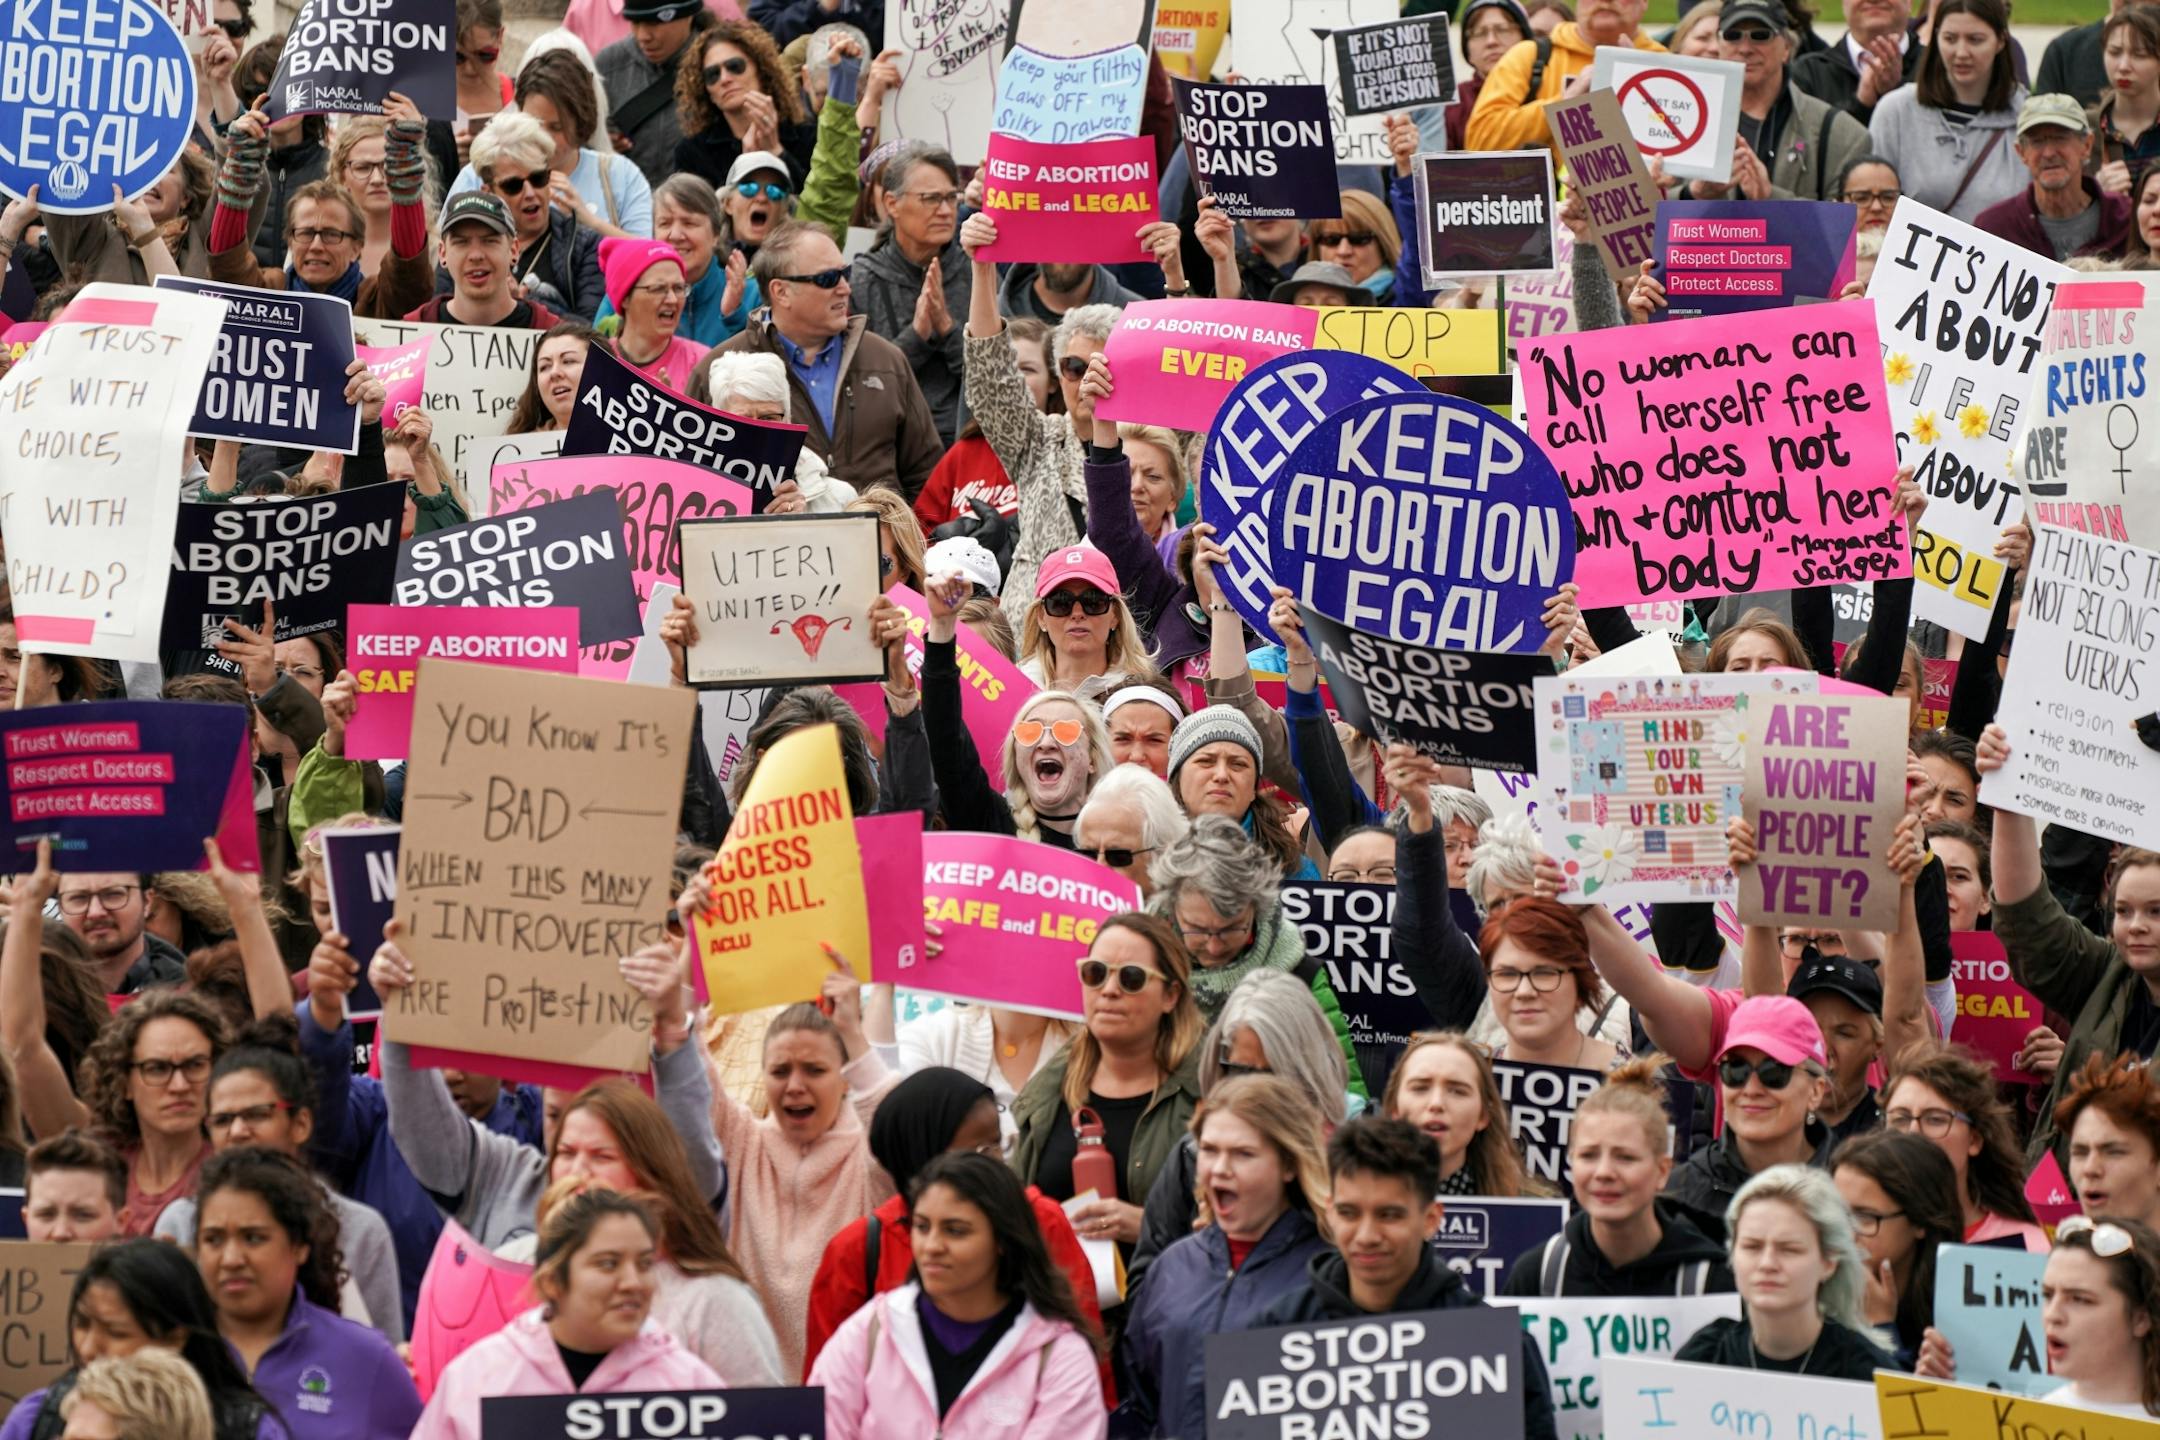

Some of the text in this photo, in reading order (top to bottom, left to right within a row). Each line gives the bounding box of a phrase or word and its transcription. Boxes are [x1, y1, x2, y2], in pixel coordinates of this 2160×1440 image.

[12, 0, 154, 49] KEEP
[298, 0, 390, 26] STOP
[959, 20, 986, 42] the
[1153, 31, 1193, 48] IGHT.
[1348, 23, 1430, 54] IF IT'S NOT
[290, 47, 394, 77] BANS
[1008, 54, 1045, 83] Keep
[1351, 43, 1433, 73] YOUR BODY
[1354, 62, 1437, 88] IT'S NOT YOUR
[0, 42, 183, 119] BORTION
[315, 87, 362, 100] NARAL
[1004, 81, 1047, 109] Laws
[1101, 94, 1127, 113] my
[1356, 78, 1440, 111] DECISION
[315, 99, 363, 112] Pro-Choice
[1191, 87, 1268, 118] STOP
[1671, 99, 1692, 110] SAY
[1051, 114, 1132, 143] Drawers
[1180, 114, 1324, 147] ABORTION
[1556, 102, 1603, 149] ARE
[989, 157, 1149, 183] KEEP ABORTION
[1196, 146, 1278, 177] BANS
[1569, 143, 1632, 188] WOMEN
[986, 187, 1151, 213] SAFE and LEGAL
[1214, 192, 1251, 205] NARAL
[1253, 207, 1295, 217] Minnesota
[1437, 194, 1544, 232] persistent
[1585, 182, 1649, 228] PEOPLE
[1673, 223, 1762, 239] Trust Women.
[1670, 251, 1787, 270] Respect Doctors.
[1894, 223, 1985, 294] IT'S
[1671, 277, 1778, 291] Protect Access.
[228, 300, 295, 321] NARAL
[80, 325, 183, 356] TRUST
[1123, 317, 1306, 350] NO ABORTION BANS.
[1322, 310, 1450, 359] STOP
[1895, 290, 2041, 373] ABOUT
[208, 332, 313, 383] RUST
[1160, 347, 1246, 382] EVER
[1619, 340, 1771, 384] woman
[1792, 330, 1856, 360] can
[70, 376, 148, 408] WITH
[204, 376, 320, 430] OMEN
[2047, 353, 2146, 417] RIGHTS
[627, 382, 736, 448] STOP
[1546, 373, 1870, 449] call herself free
[19, 429, 121, 465] CHOICE,
[581, 384, 786, 490] ABORTION
[1337, 403, 1524, 492] KEEP
[2024, 426, 2067, 481] ARE
[1561, 450, 1643, 498] who
[1656, 436, 1747, 484] does
[1767, 421, 1851, 474] not
[1815, 475, 1893, 525] her
[1913, 447, 2021, 525] ABOUT
[46, 497, 127, 527] WITH
[212, 501, 337, 540] STOP
[1283, 473, 1561, 588] ABORTION
[411, 516, 537, 572] STOP
[2041, 528, 2136, 592] THINGS
[11, 559, 127, 608] CHILD?
[711, 544, 834, 586] UTERI
[1793, 552, 1900, 585] Sanger
[207, 563, 331, 606] BANS
[706, 584, 841, 622] UNITED!!
[1301, 561, 1524, 654] LEGAL
[2028, 577, 2160, 653] NOT BELONG
[290, 619, 337, 638] Minnesota
[357, 635, 420, 657] KEEP
[427, 636, 567, 657] ABORTION
[205, 653, 231, 672] SHE
[1350, 633, 1471, 677] STOP
[2066, 640, 2146, 701] UTERUS
[358, 669, 414, 693] SAF
[1364, 686, 1495, 734] BANS
[1764, 704, 1851, 749] ARE
[2047, 702, 2114, 736] religion
[11, 730, 134, 753] Trust Women.
[1643, 720, 1704, 742] MIND
[1467, 757, 1524, 772] Minnesota
[1644, 748, 1700, 770] YOUR
[2034, 754, 2060, 774] men
[2040, 731, 2139, 770] the government
[13, 761, 168, 787] Respect Doctors.
[1654, 773, 1704, 796] OWN
[1763, 757, 1876, 803] WOMEN
[16, 792, 159, 815] Protect Access.
[484, 775, 569, 843] BAD
[1630, 802, 1717, 826] UTERUS
[1758, 811, 1873, 858] PEOPLE
[405, 849, 482, 887] WHEN
[510, 865, 566, 894] THIS
[582, 871, 652, 907] MANY
[768, 877, 825, 917] ALL.
[924, 861, 1132, 914] KEEP ABORTION
[1758, 865, 1870, 917] YET?
[432, 900, 664, 958] INTROVERTS
[924, 896, 1034, 936] SAFE and
[710, 932, 752, 955] ACLU
[1280, 1320, 1426, 1371] STOP
[1584, 1314, 1671, 1358] YOUR
[1217, 1354, 1507, 1419] ABORTION
[566, 1394, 727, 1440] STOP
[1638, 1388, 1676, 1427] I
[1711, 1400, 1772, 1439] am
[1885, 1386, 1949, 1439] I
